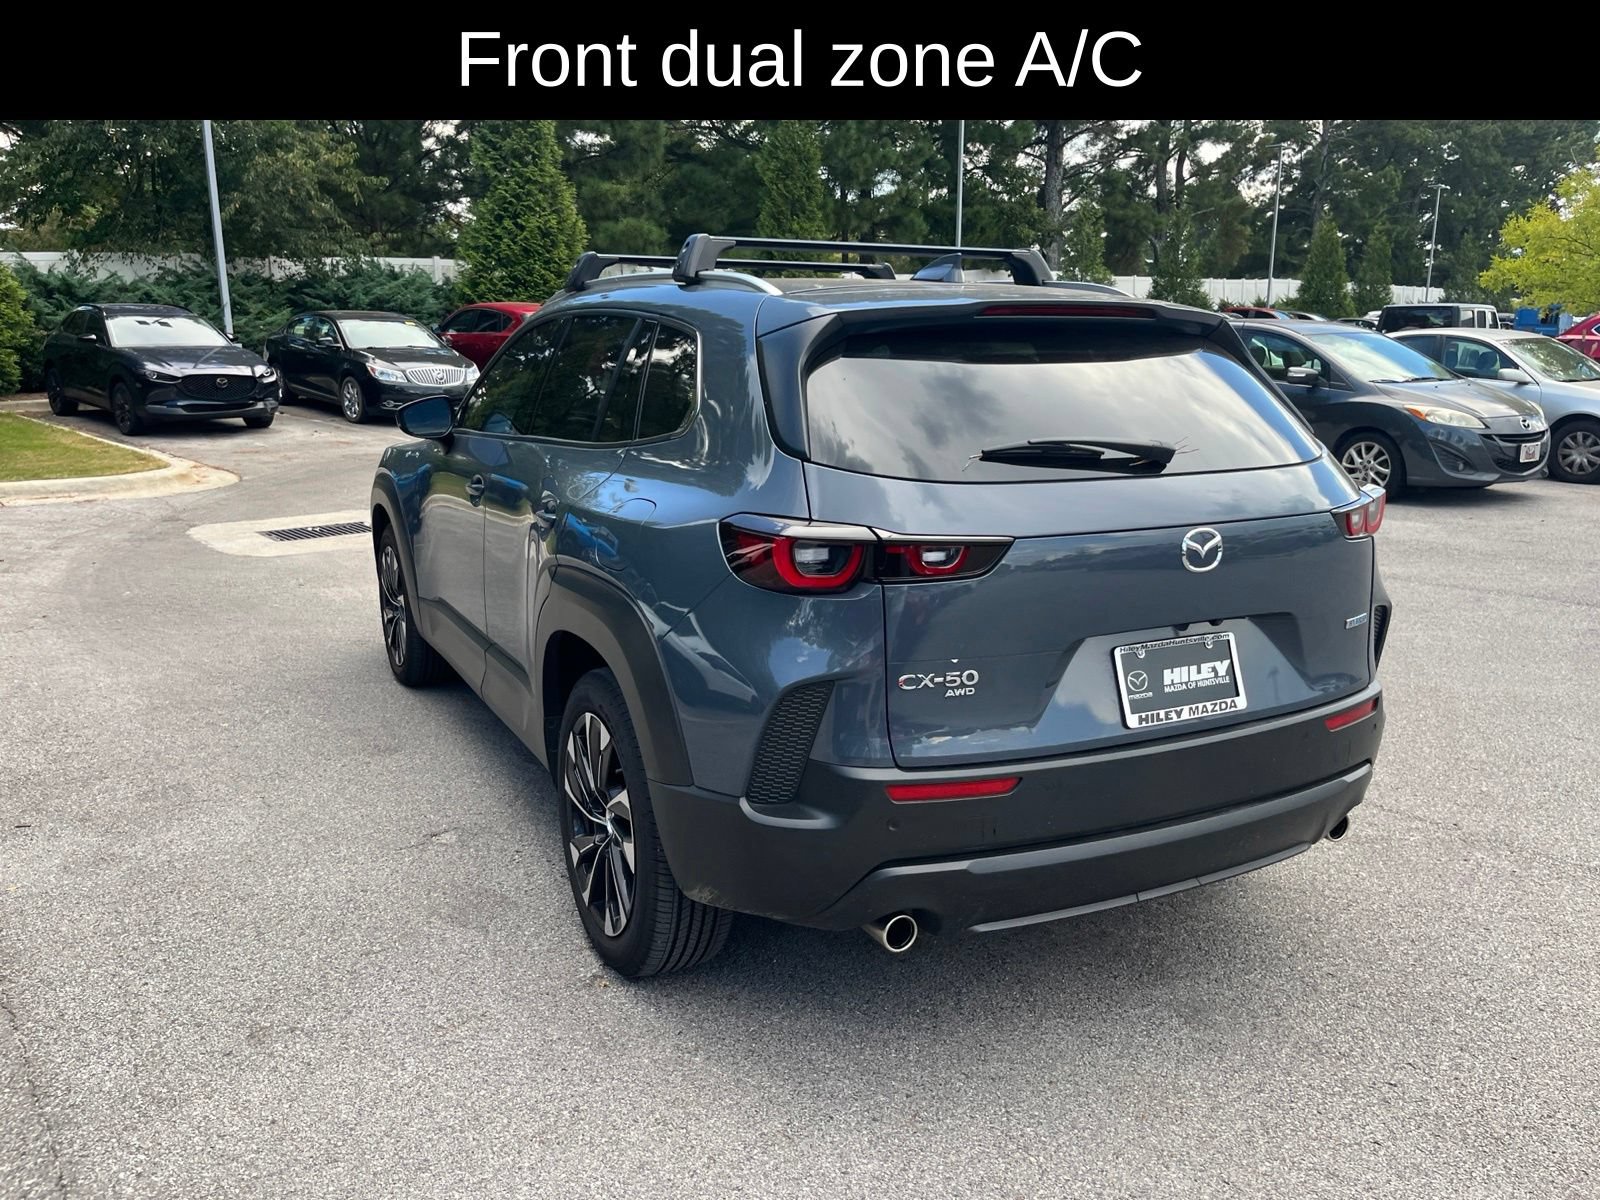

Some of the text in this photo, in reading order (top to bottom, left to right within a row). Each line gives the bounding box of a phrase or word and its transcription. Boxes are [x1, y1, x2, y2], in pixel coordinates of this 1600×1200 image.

[898, 669, 979, 690] CX-50
[1163, 659, 1231, 685] HILEY
[944, 687, 976, 698] AWD
[1164, 676, 1230, 693] MAZDA OF HUNTSVILLE
[1137, 699, 1238, 726] HILEY MAZDA
